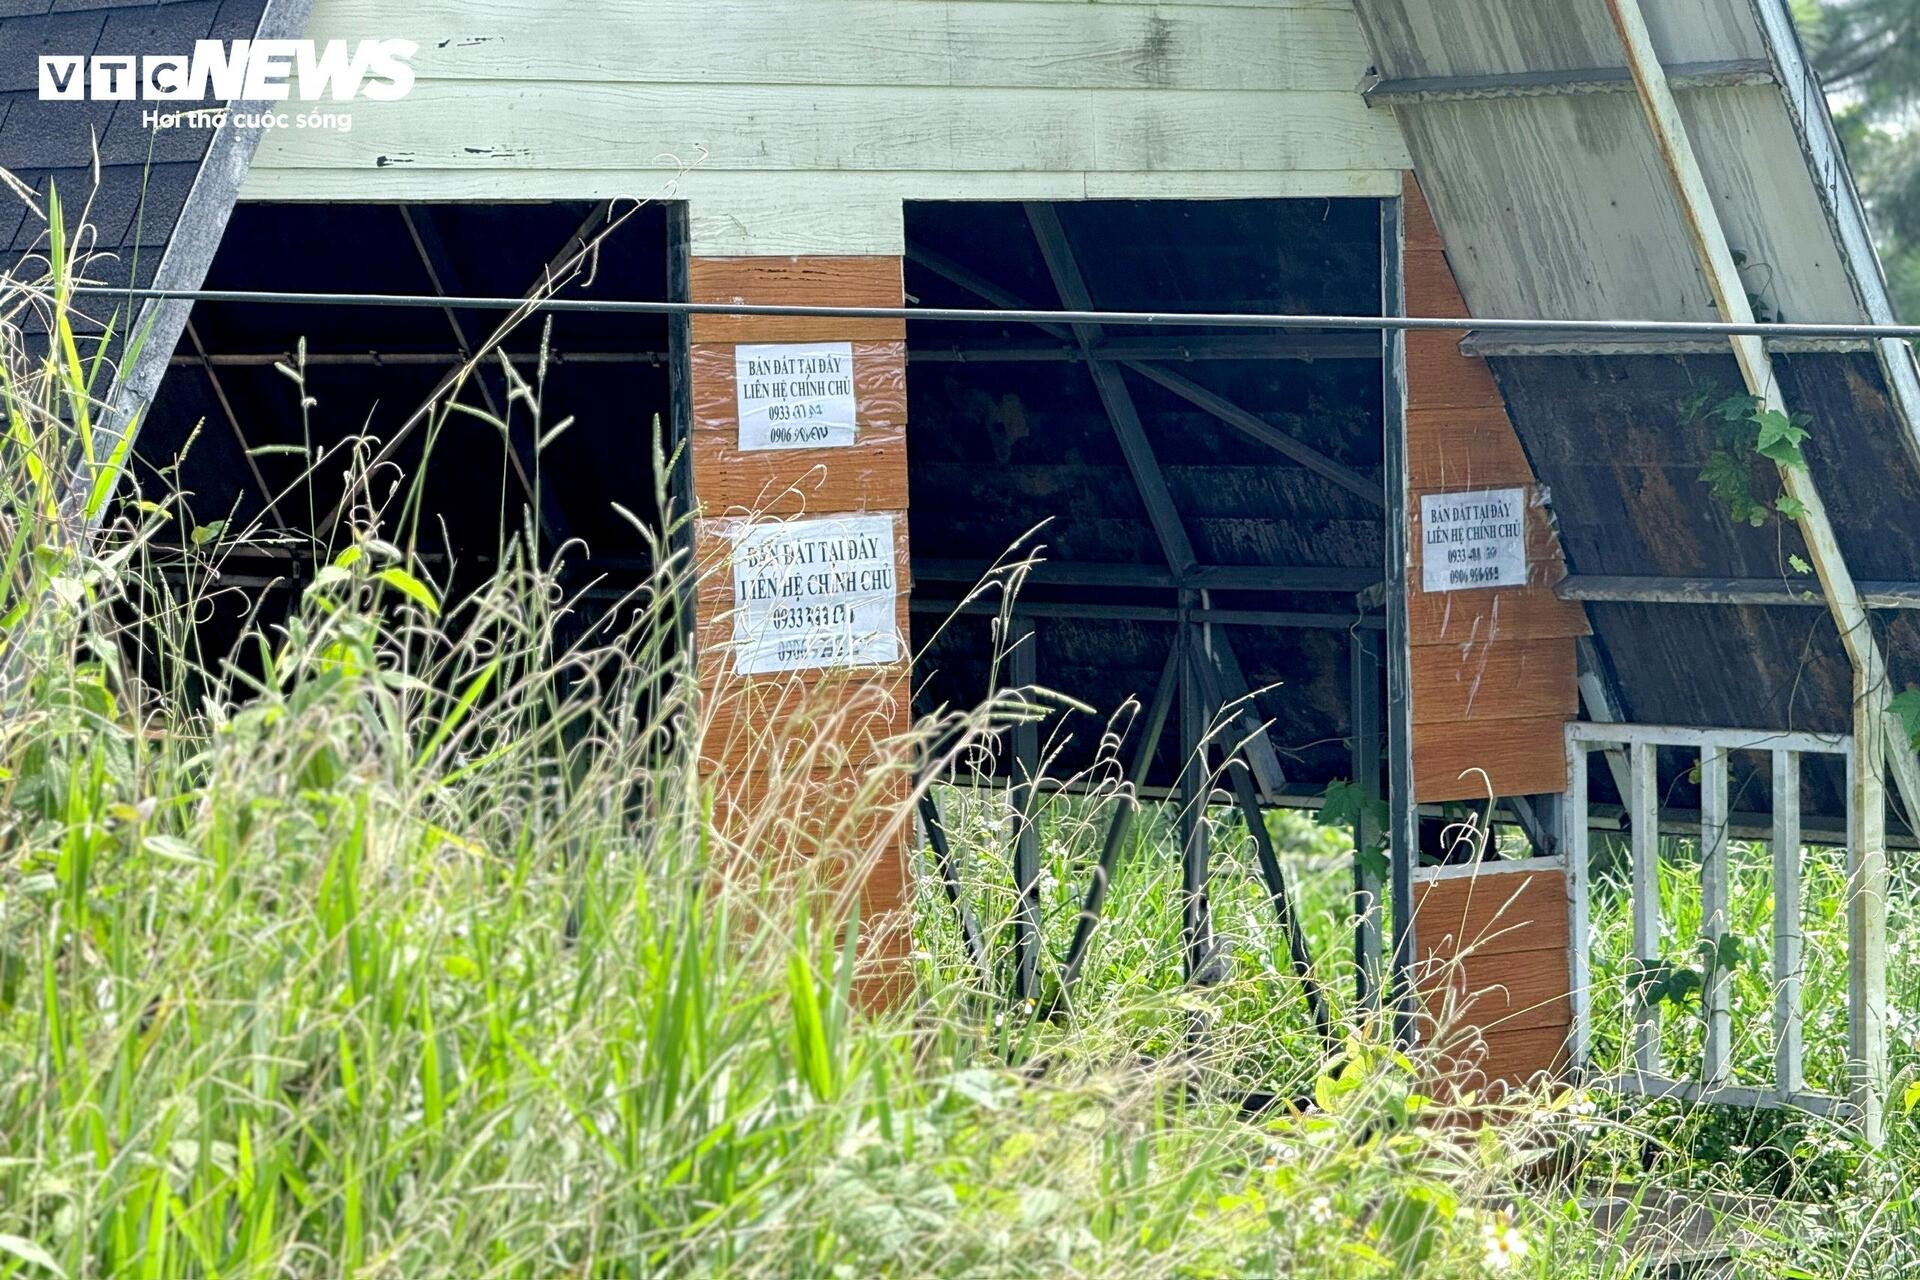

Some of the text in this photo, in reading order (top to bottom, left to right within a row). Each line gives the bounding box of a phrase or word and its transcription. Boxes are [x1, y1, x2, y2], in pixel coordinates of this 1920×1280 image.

[748, 356, 771, 376] BÁN
[797, 358, 817, 377] TẠI
[819, 354, 842, 373] ĐÂY
[743, 376, 851, 402] LIÊN HỆ CHÍNH CHỦ
[768, 405, 790, 421] 0933
[770, 428, 792, 443] 0906
[1431, 505, 1451, 523] BÁN
[1490, 500, 1511, 519] ĐÂY
[1426, 519, 1521, 545] LIÊN HỆ CHÍNH CHỦ
[848, 532, 878, 561] ĐÂY
[1447, 548, 1467, 563] 0933
[807, 568, 857, 596] CHNH
[860, 562, 892, 592] CHỦ
